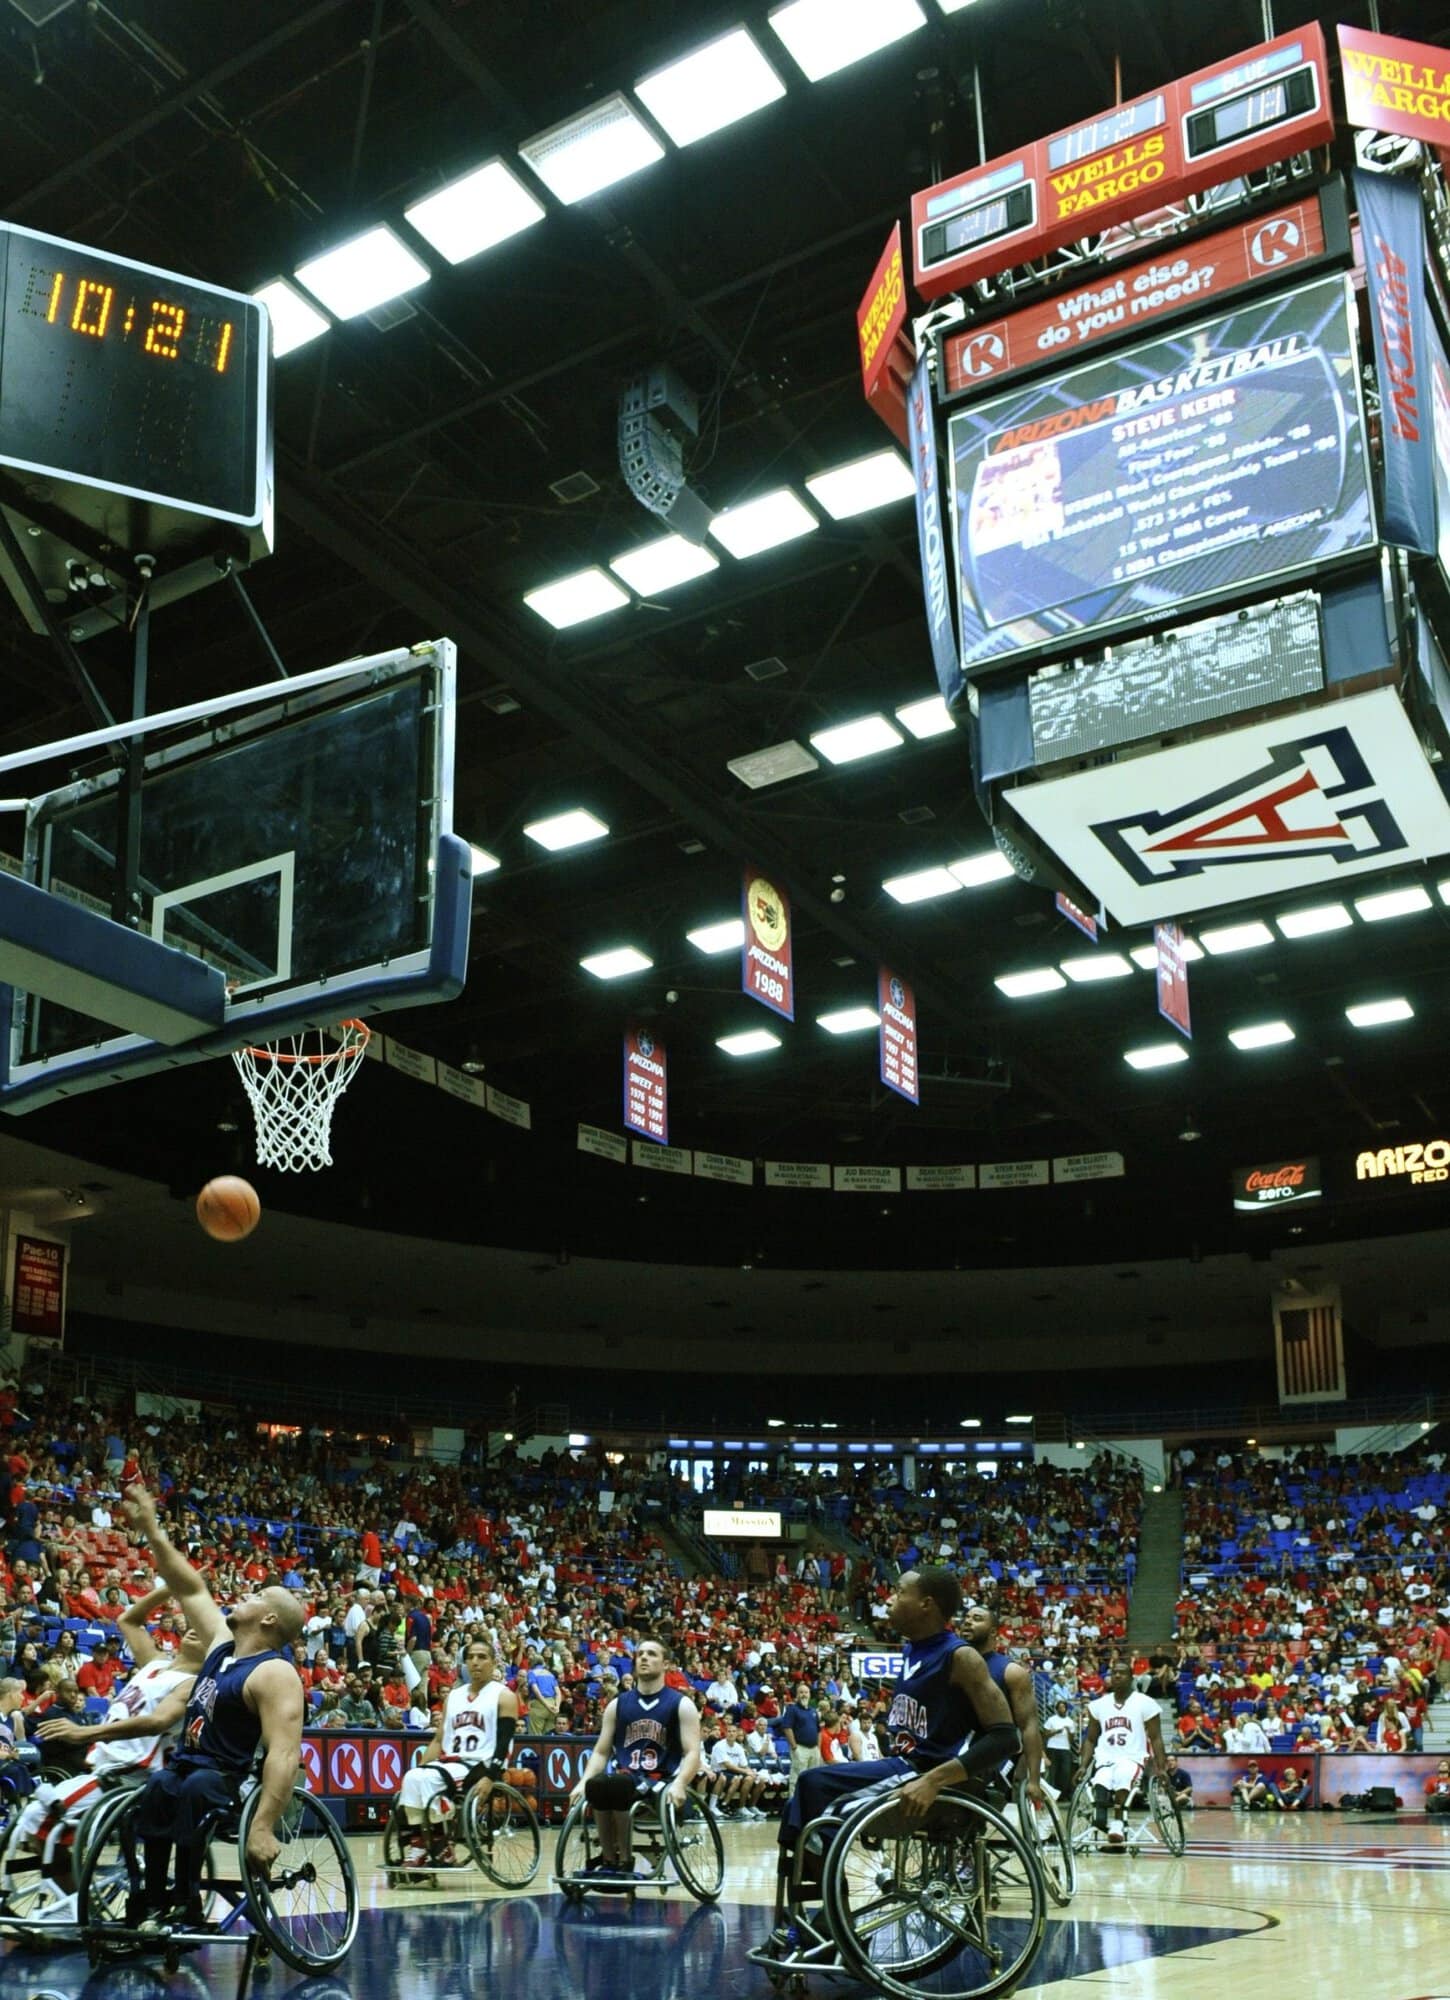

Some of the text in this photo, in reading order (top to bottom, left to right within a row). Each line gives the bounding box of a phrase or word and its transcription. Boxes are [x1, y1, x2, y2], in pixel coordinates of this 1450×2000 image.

[1065, 95, 1164, 163] 10:21
[1050, 134, 1165, 194] WELLS
[1057, 160, 1165, 219] FARGO
[860, 248, 901, 342] WELLS
[1037, 267, 1215, 350] do you need?
[1058, 259, 1189, 321] What else
[47, 272, 234, 373] 10:21
[1374, 233, 1420, 444] ARIZONA
[993, 336, 1302, 453] ARIZONA BASKETBALL
[1111, 389, 1237, 442] STEVE KERR
[924, 491, 948, 637] DOWN
[748, 945, 789, 979] ARIZONA
[754, 970, 783, 1002] 1988
[628, 1051, 664, 1078] ARIZONA
[1411, 1167, 1448, 1184] RED
[453, 1734, 479, 1753] 20
[624, 1718, 667, 1749] ARIZONA
[1105, 1716, 1133, 1732] ARIZONA
[1107, 1733, 1127, 1746] 45
[628, 1748, 658, 1771] 13
